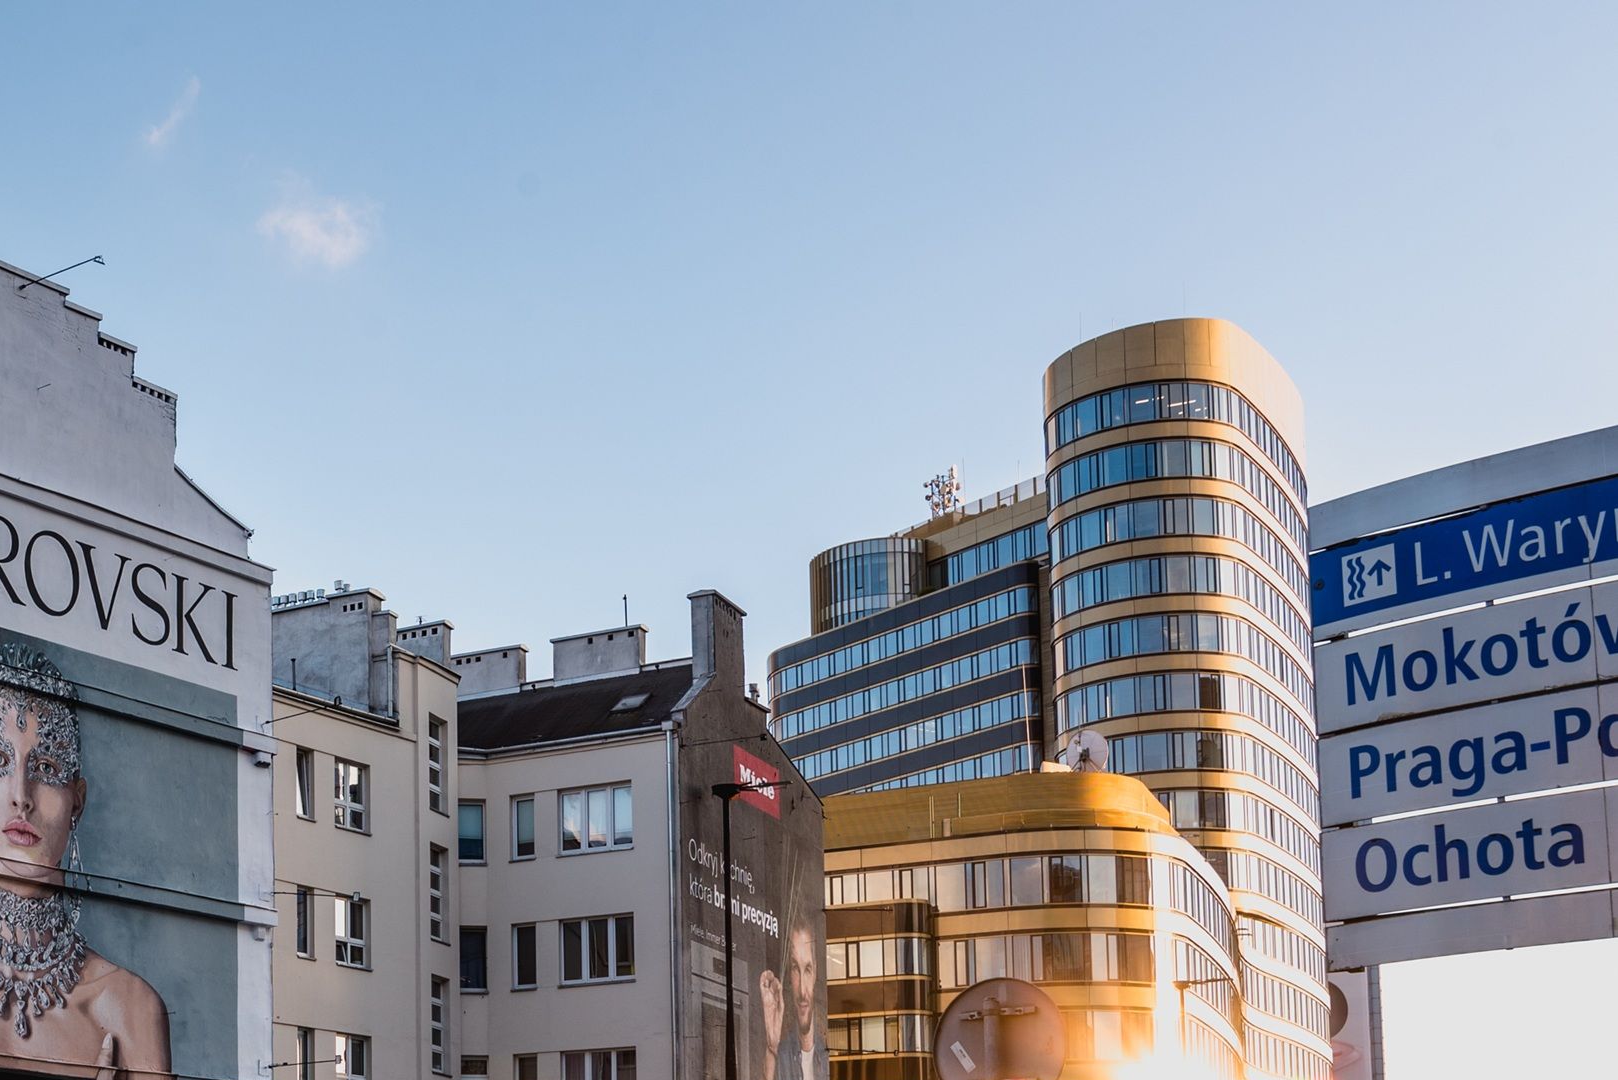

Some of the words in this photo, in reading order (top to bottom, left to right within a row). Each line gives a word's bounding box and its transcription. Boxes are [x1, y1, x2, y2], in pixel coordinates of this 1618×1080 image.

[1414, 541, 1452, 587] L.
[1462, 508, 1618, 574] Wary
[739, 763, 775, 800] Miele
[688, 838, 719, 878] Odkryj
[720, 851, 755, 895] kchnię,
[1355, 818, 1586, 893] Ochota
[689, 873, 712, 904] która
[713, 884, 740, 917] brmi
[741, 900, 779, 939] precyzją
